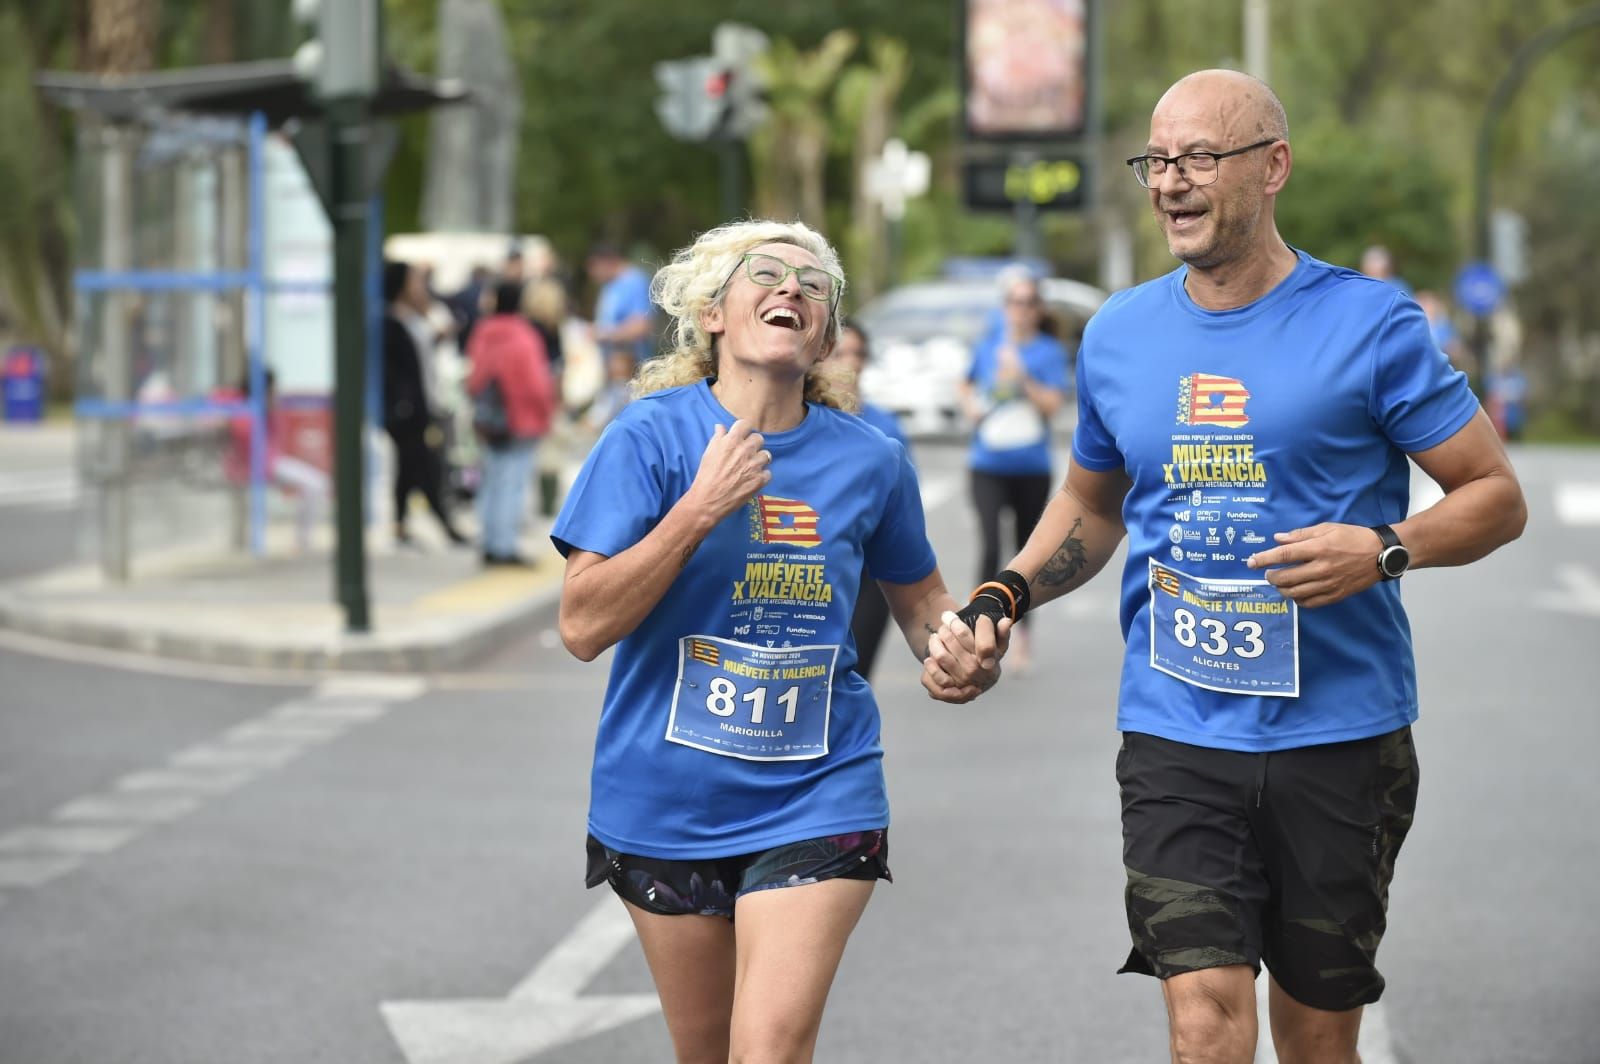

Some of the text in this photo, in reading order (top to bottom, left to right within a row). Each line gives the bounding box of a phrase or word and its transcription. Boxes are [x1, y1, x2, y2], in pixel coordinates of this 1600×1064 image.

[1172, 441, 1254, 464] MUÉVETE
[1162, 463, 1267, 483] X VALENCIA
[745, 559, 824, 584] MUÉVETE
[732, 581, 832, 602] X VALENCIA
[1225, 601, 1233, 612] X
[1235, 601, 1288, 614] VALENCIA
[1174, 608, 1265, 658] 833
[723, 659, 826, 680] MUÉVETE X VALENCIA
[1193, 656, 1239, 671] ALICATES
[706, 677, 799, 724] 811
[720, 722, 783, 738] MARIQUILLA
